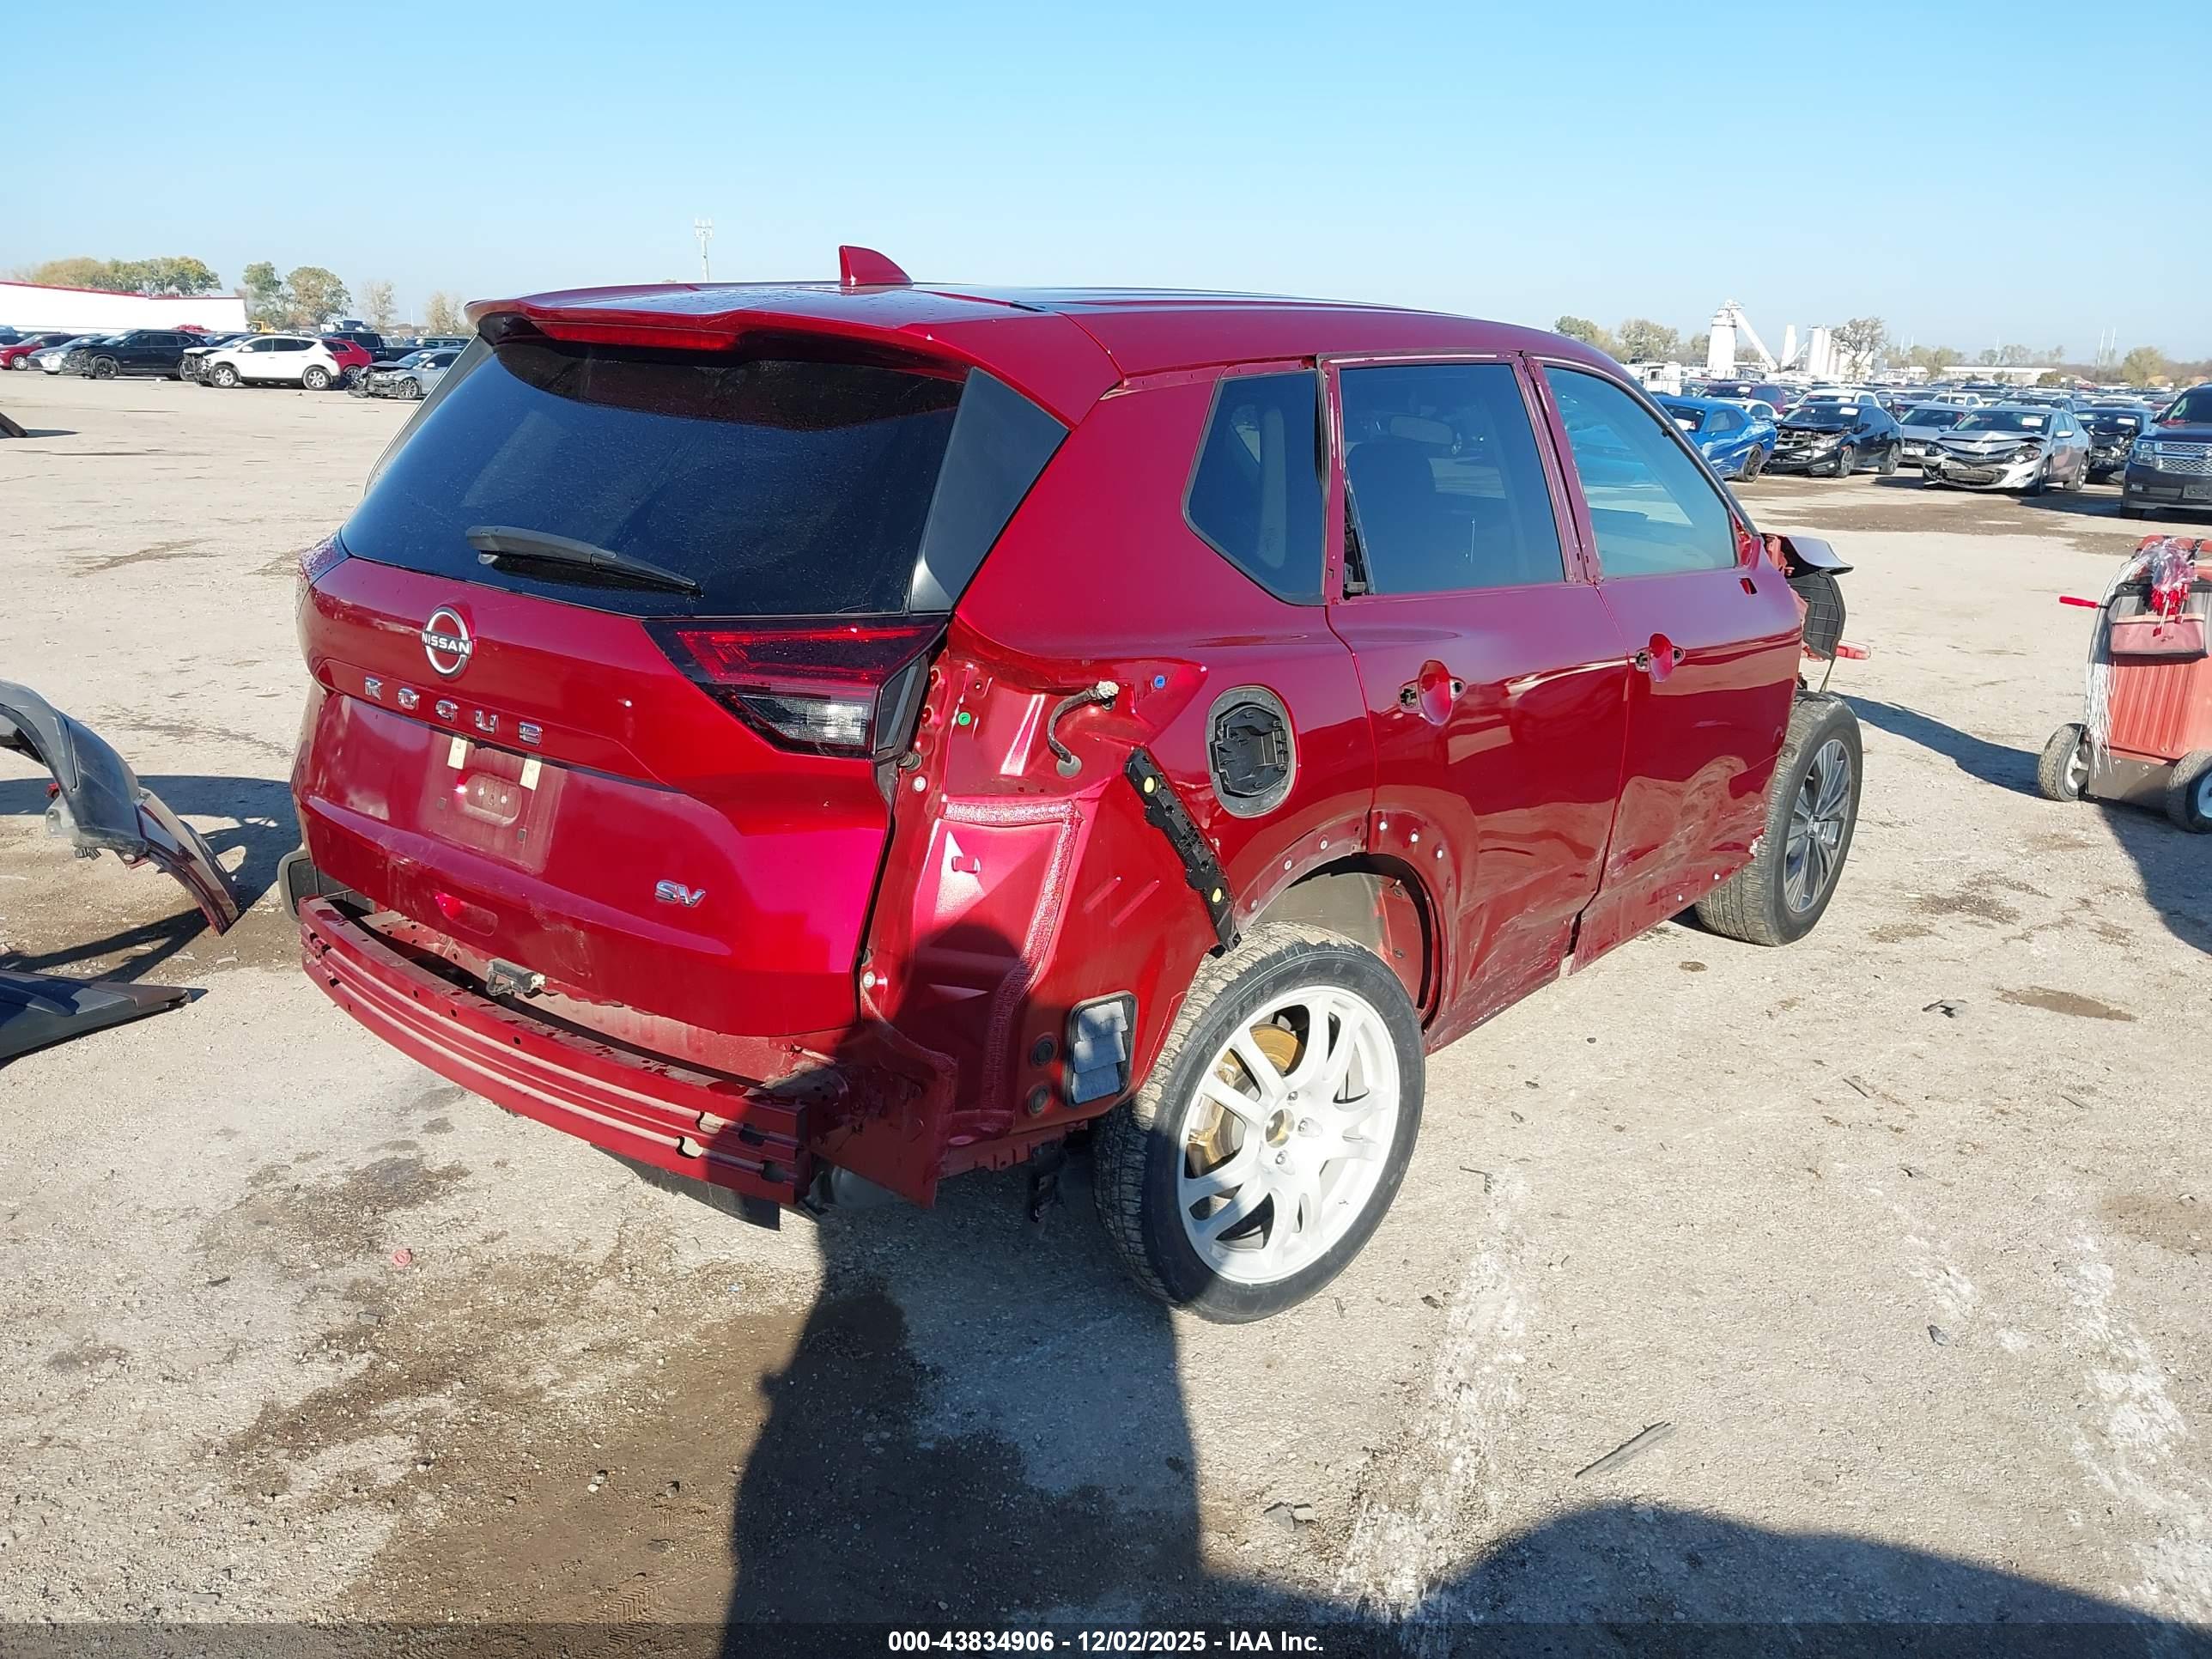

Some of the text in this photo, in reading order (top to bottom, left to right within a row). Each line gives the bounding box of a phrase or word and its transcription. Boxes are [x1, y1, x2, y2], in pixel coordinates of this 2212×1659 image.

[421, 631, 471, 654] NISSAN
[364, 674, 544, 747] ROGUE
[654, 879, 706, 908] SV
